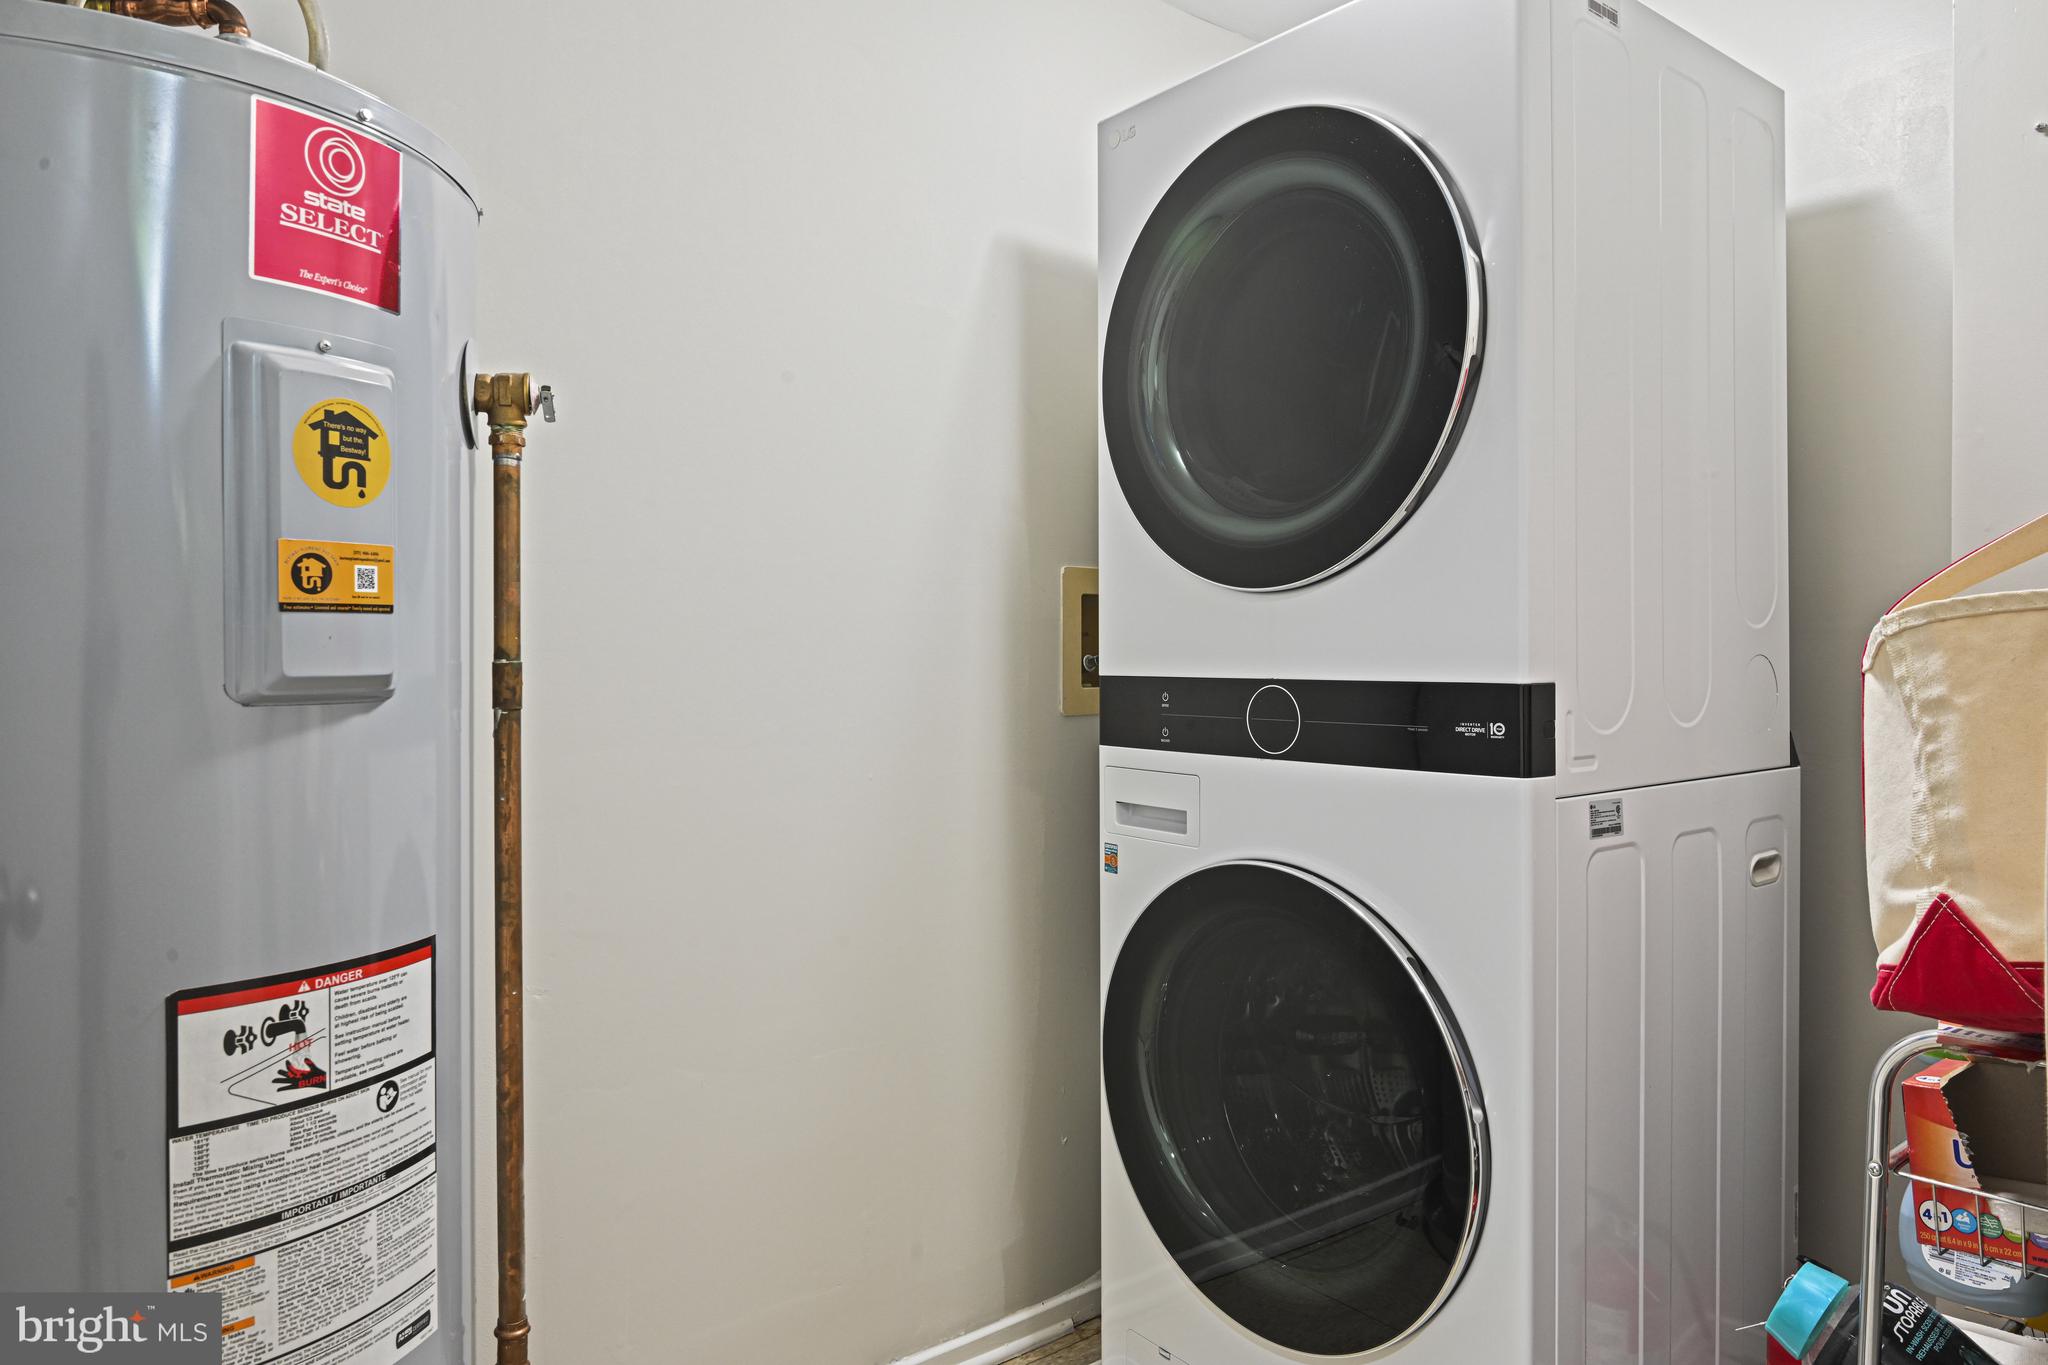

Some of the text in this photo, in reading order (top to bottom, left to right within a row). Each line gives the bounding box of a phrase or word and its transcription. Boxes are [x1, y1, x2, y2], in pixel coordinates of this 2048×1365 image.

[304, 190, 366, 222] state
[280, 203, 382, 248] SELECT
[300, 269, 366, 294] The Expert's Choice
[323, 421, 345, 431] There's
[341, 446, 366, 456] Bestway!
[315, 968, 362, 990] DANGER
[298, 1074, 326, 1087] BURN
[172, 1135, 194, 1144] WATER
[196, 1125, 240, 1138] TEMPERATURE
[246, 1120, 259, 1128] TIME
[270, 1111, 296, 1121] PRODUCE
[297, 1104, 319, 1114] SERIOUS
[320, 1099, 337, 1107] BURNS
[346, 1091, 360, 1099] ADULT
[173, 1157, 285, 1188] Install Thermostatic Mixing Valves
[174, 1193, 221, 1208] Requirements
[224, 1187, 241, 1196] when
[243, 1182, 261, 1190] using
[268, 1167, 308, 1184] supplemental
[309, 1161, 320, 1170] heat
[323, 1157, 340, 1166] source
[281, 1195, 333, 1220] IMPORTANT
[340, 1172, 386, 1200] IMPORTANTE
[1923, 1209, 1948, 1223] 4 1
[1920, 1231, 1930, 1239] 250
[1906, 1330, 1924, 1355] IN-WASH
[1915, 1328, 1940, 1361] REHAUSSEUR
